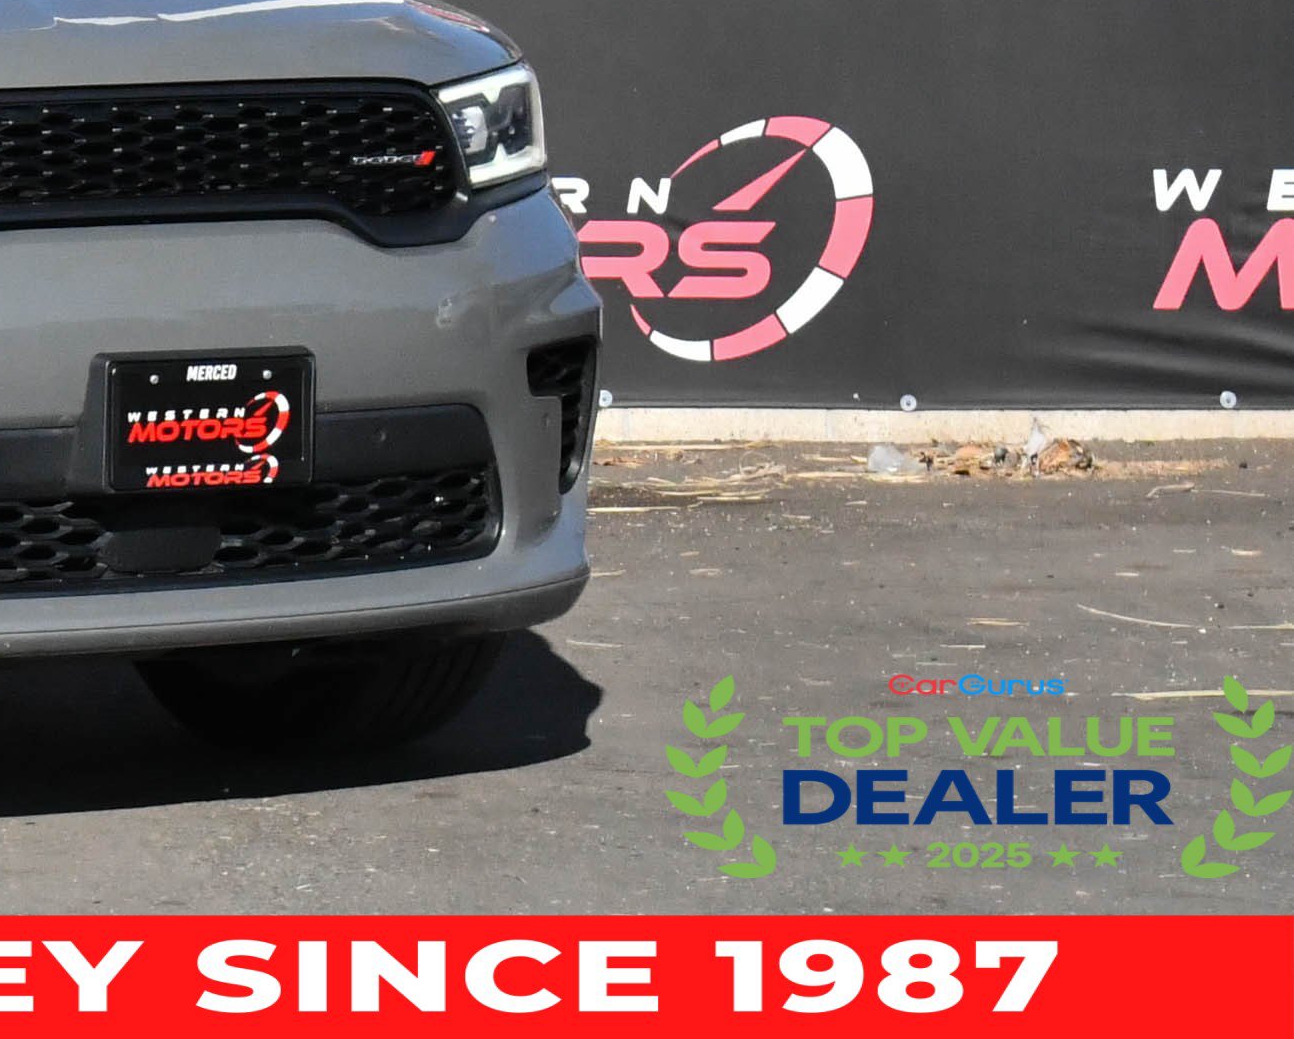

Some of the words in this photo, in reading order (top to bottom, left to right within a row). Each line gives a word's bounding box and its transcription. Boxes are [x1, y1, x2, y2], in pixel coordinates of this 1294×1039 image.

[186, 364, 238, 382] MERCED
[127, 407, 246, 423] WESTERN
[127, 417, 268, 444] MOTORS
[145, 463, 245, 475] WESTERN
[145, 469, 263, 488] MOTORS
